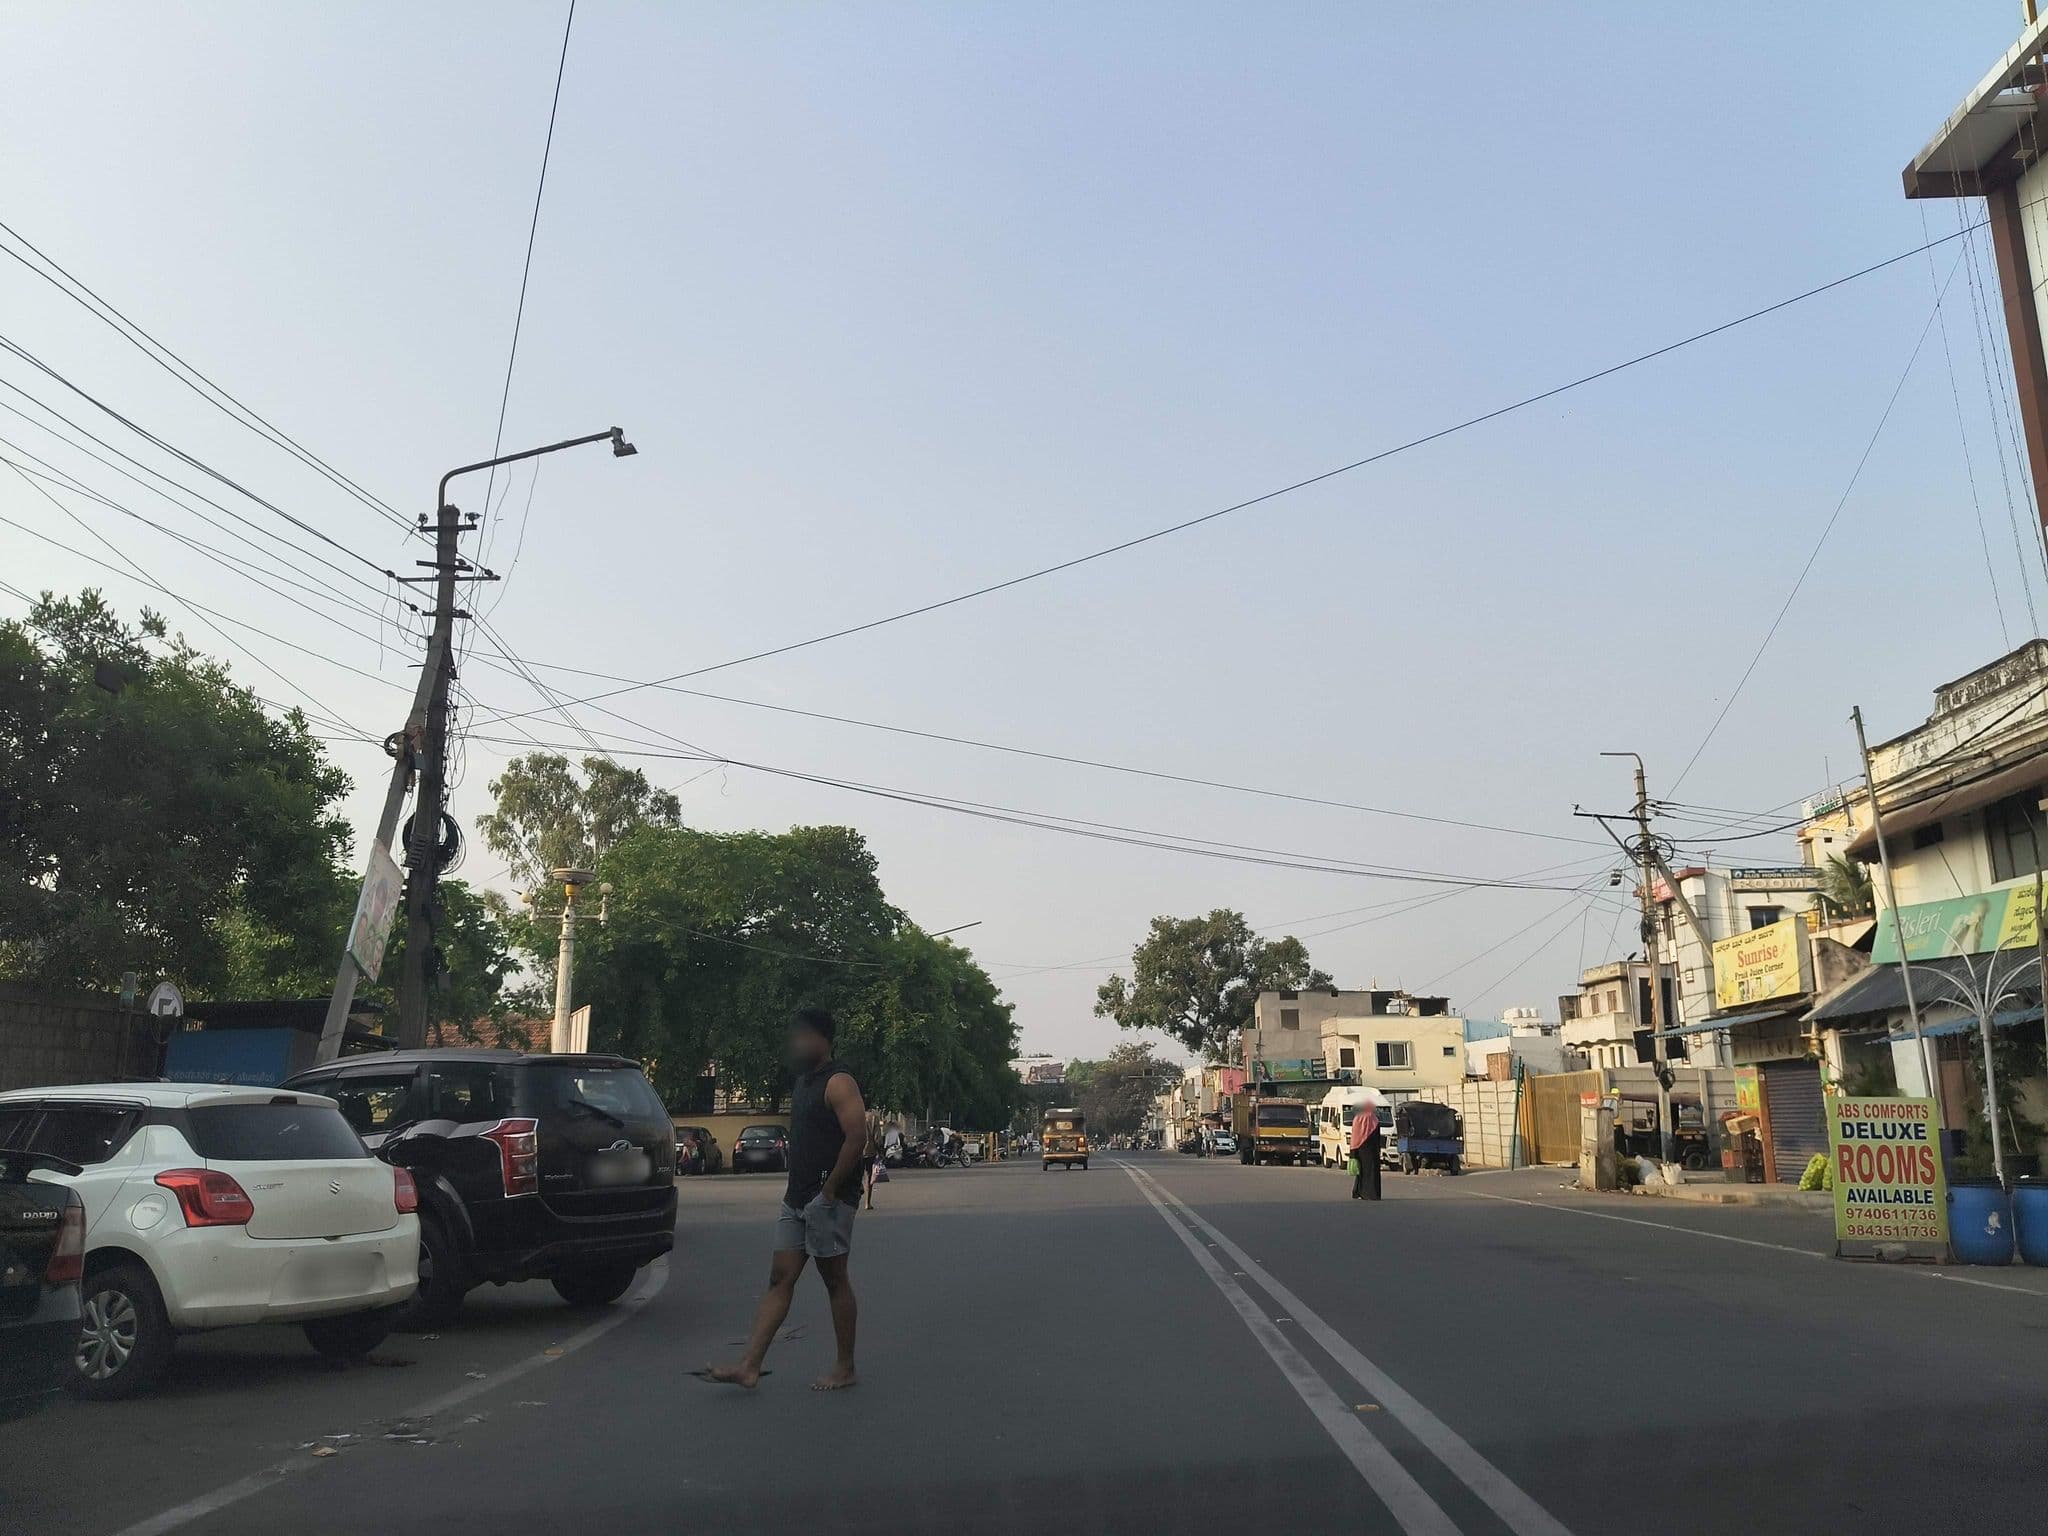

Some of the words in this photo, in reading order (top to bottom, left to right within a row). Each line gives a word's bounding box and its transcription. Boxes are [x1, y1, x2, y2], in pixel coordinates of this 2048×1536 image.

[1737, 943, 1779, 968] Sunrise
[1734, 969, 1748, 981] Fruit
[1749, 967, 1764, 978] Juice
[1764, 961, 1784, 974] Corner
[1836, 1103, 1860, 1119] ABS
[1863, 1104, 1929, 1119] COMFORTS
[1841, 1121, 1927, 1140] DELUXE
[1837, 1144, 1936, 1185] ROOMS
[1846, 1188, 1934, 1205] AVAILABLE
[1845, 1208, 1937, 1221] 9740611736
[1847, 1224, 1938, 1238] 9843511736
